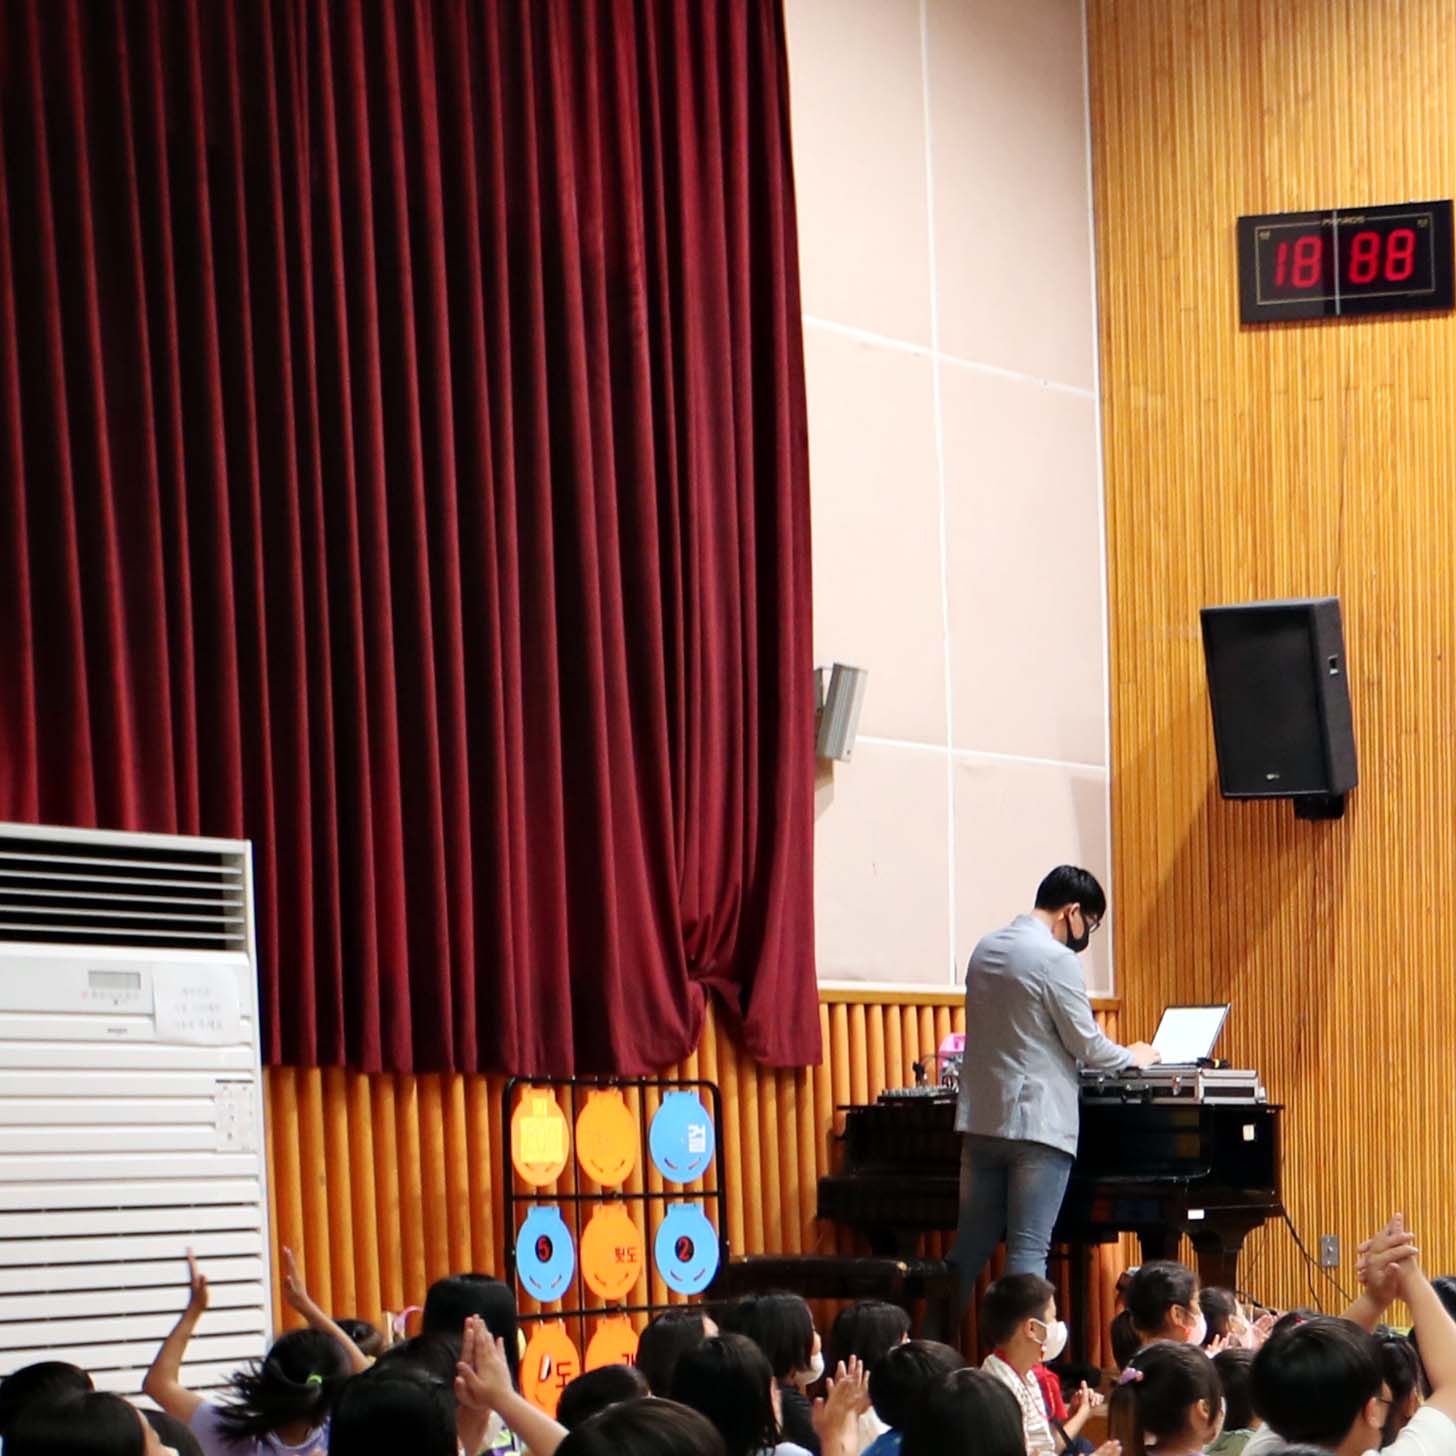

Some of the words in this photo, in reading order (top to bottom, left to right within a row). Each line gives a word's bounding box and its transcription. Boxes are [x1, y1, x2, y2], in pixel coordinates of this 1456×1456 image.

[1275, 235, 1323, 288] 18
[1349, 228, 1416, 284] 88
[678, 1236, 691, 1261] 2
